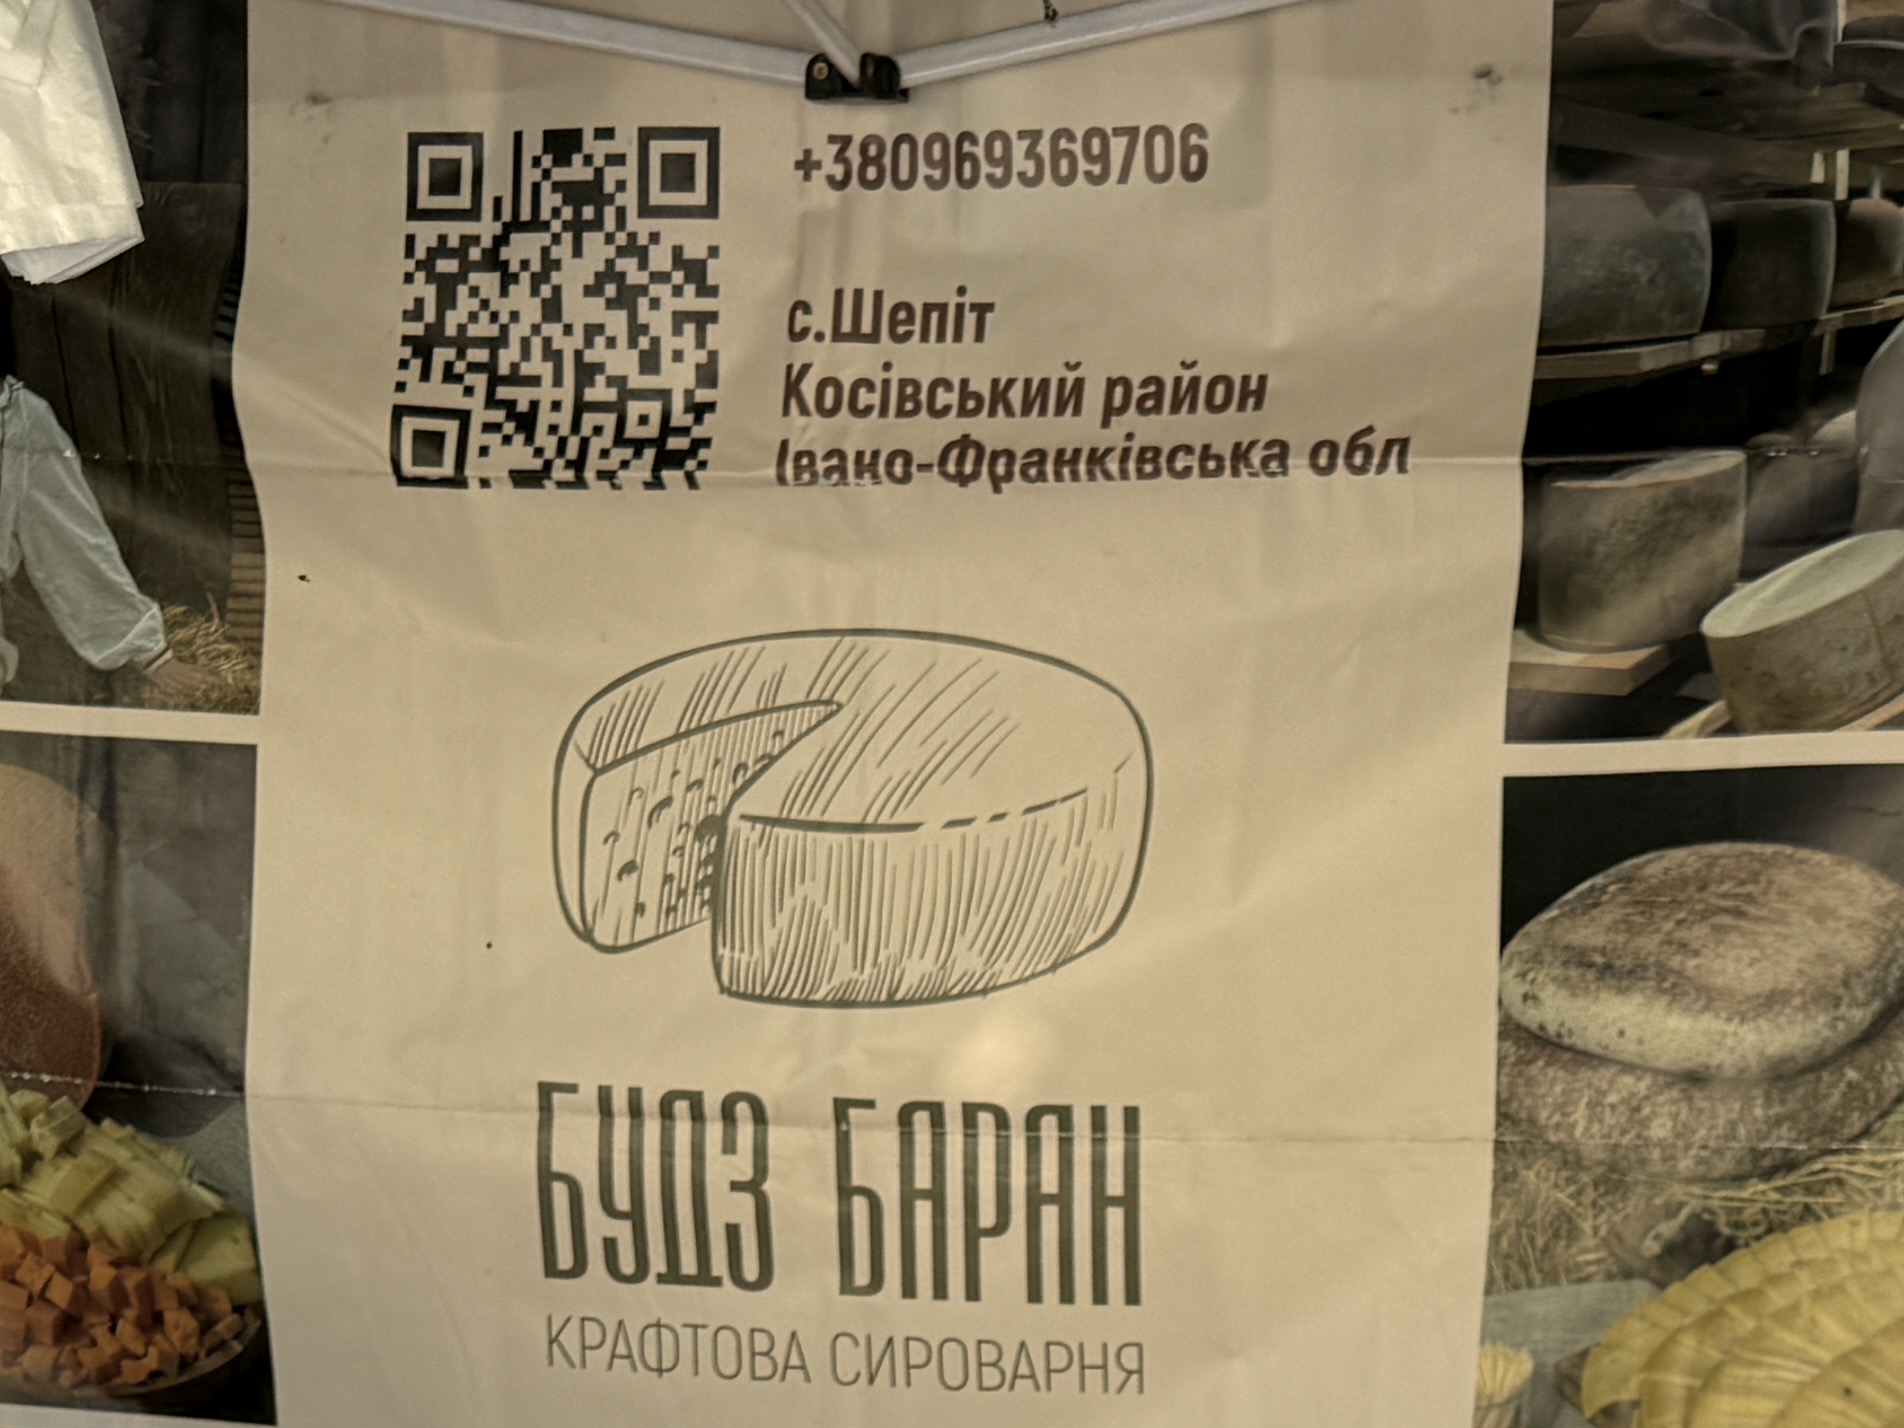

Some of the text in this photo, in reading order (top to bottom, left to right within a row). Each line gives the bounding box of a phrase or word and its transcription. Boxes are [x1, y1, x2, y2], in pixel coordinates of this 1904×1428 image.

[793, 122, 1210, 192] +380969369706
[786, 284, 996, 345] с.Шепіт
[780, 359, 1269, 429] Косівський район
[775, 424, 1412, 494] Івано-Франківська обл
[536, 1080, 1143, 1307] БУДЗ БАРАН
[546, 1313, 1145, 1396] КРАФТОВА СИРОВАРНЯ
